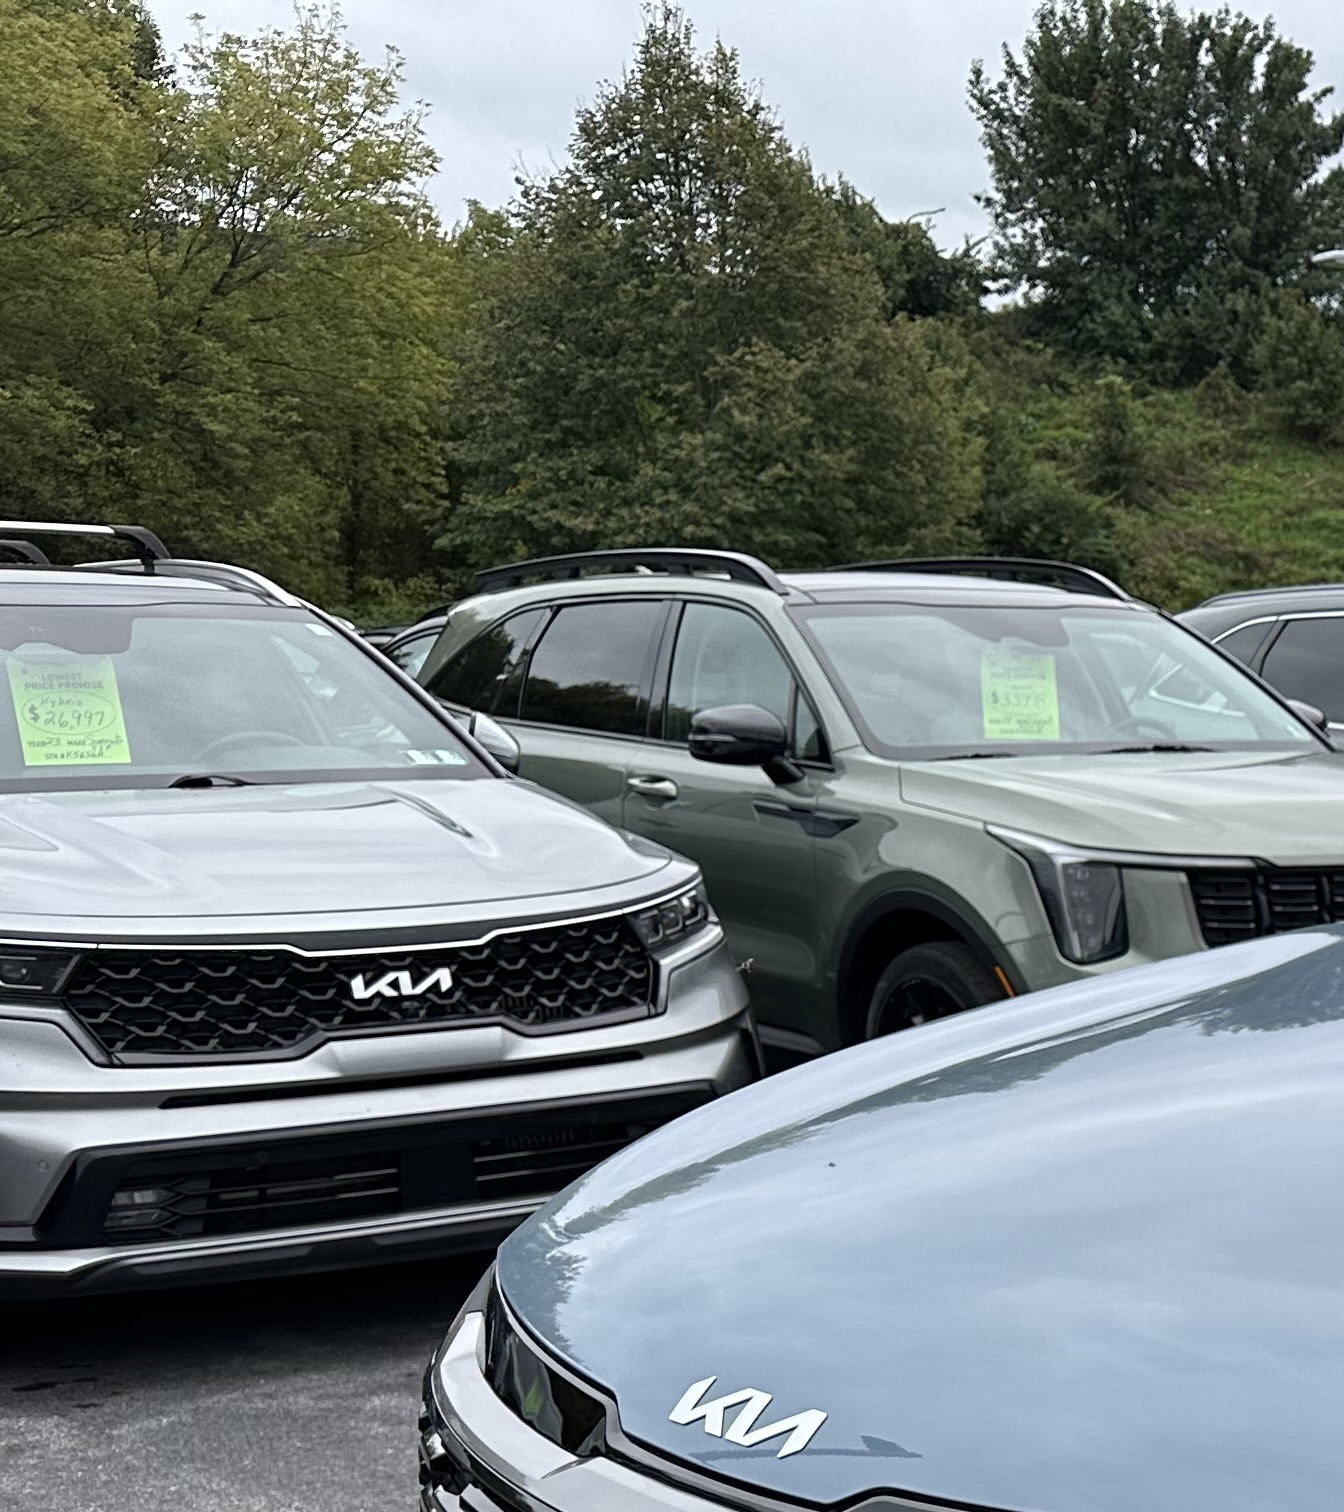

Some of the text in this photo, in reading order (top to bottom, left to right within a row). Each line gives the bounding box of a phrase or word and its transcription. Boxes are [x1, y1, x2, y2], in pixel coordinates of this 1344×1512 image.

[25, 681, 104, 690] PRICE PROMISE
[42, 673, 83, 682] LOWEST
[350, 967, 453, 1000] KIA
[668, 1375, 829, 1460] KIA
